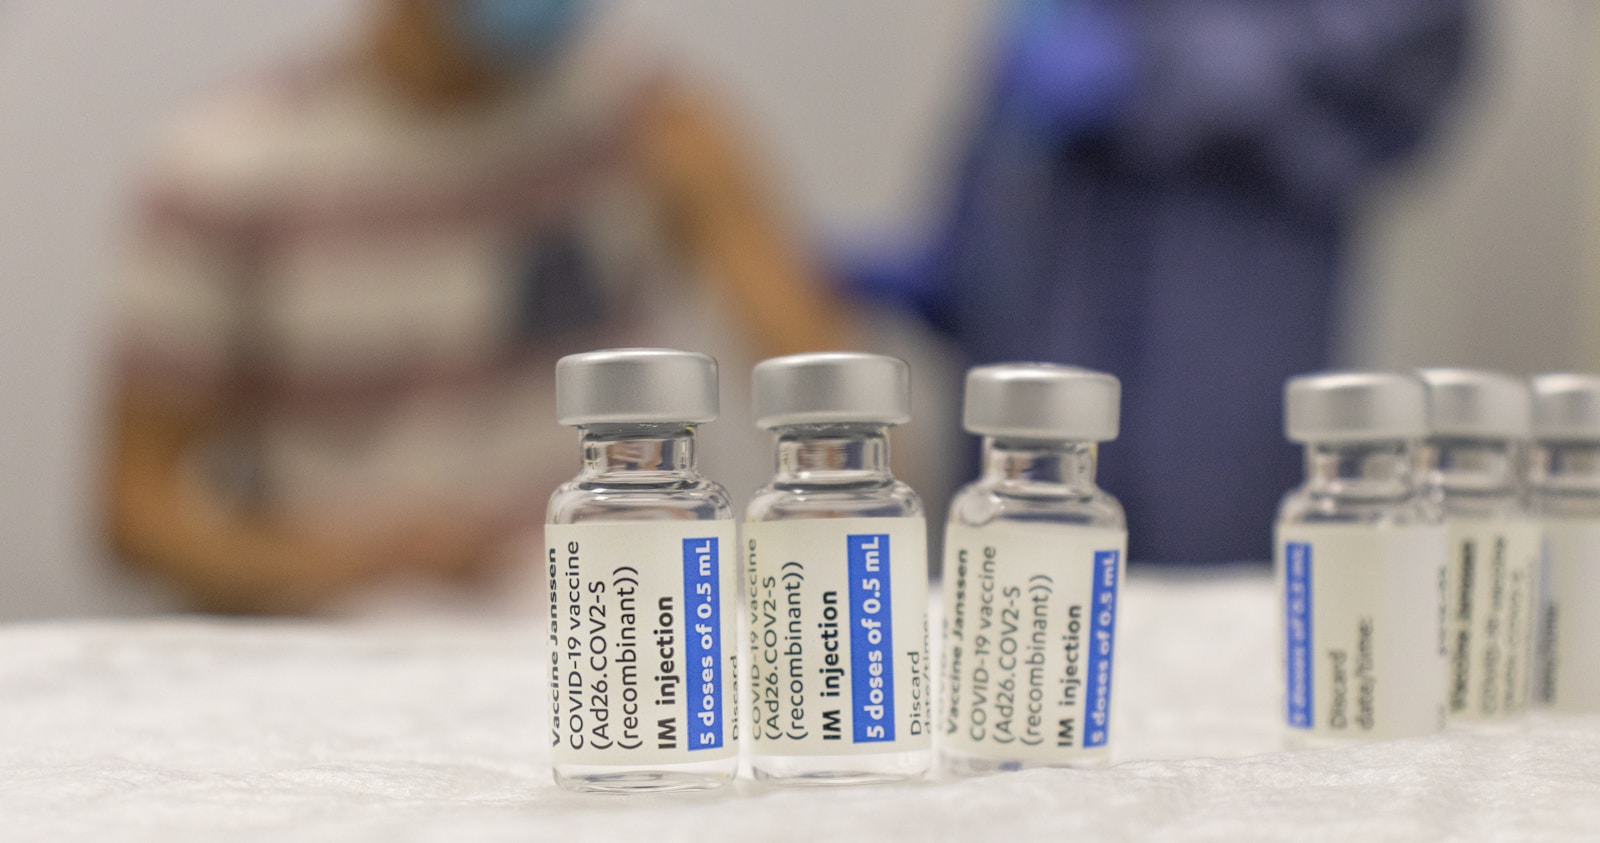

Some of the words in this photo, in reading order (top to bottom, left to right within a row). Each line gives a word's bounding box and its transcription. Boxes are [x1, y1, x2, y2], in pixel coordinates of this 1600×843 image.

[565, 541, 581, 630] vaccine
[695, 540, 711, 576] mL
[748, 539, 758, 623] vaccine
[861, 536, 880, 572] mL
[862, 578, 881, 614] 0.5
[953, 549, 968, 641] Janssen
[978, 546, 997, 630] vaccine
[1103, 554, 1116, 587] mL
[549, 548, 558, 646] Janssen
[696, 582, 712, 618] 0.5
[696, 624, 712, 649] of
[861, 618, 882, 644] of
[1099, 591, 1113, 627] 0.5
[588, 581, 613, 750] (Ad26.COV2-S
[613, 566, 643, 750] (recombinant))
[653, 597, 680, 705] injection
[763, 576, 783, 740] (Ad26.COV2-S
[781, 561, 808, 740] (recombinant))
[818, 591, 845, 697] injection
[993, 586, 1021, 744] (Ad26.COV2-S
[1020, 575, 1054, 746] (recombinant))
[1059, 605, 1082, 706] injection
[1097, 630, 1110, 655] of
[550, 651, 561, 747] Vaccine
[567, 636, 584, 750] COVID-19
[698, 656, 715, 727] doses
[750, 631, 761, 740] COVID-19
[823, 709, 842, 740] IM
[864, 650, 884, 720] doses
[907, 651, 922, 736] Discard
[947, 646, 963, 735] Vaccine
[970, 635, 991, 742] COVID-19
[1091, 660, 1108, 726] doses
[1328, 649, 1348, 730] Discard
[658, 718, 677, 749] IM
[700, 732, 715, 745] 5
[867, 725, 884, 738] 5
[1057, 718, 1075, 747] IM
[1091, 730, 1105, 743] 5
